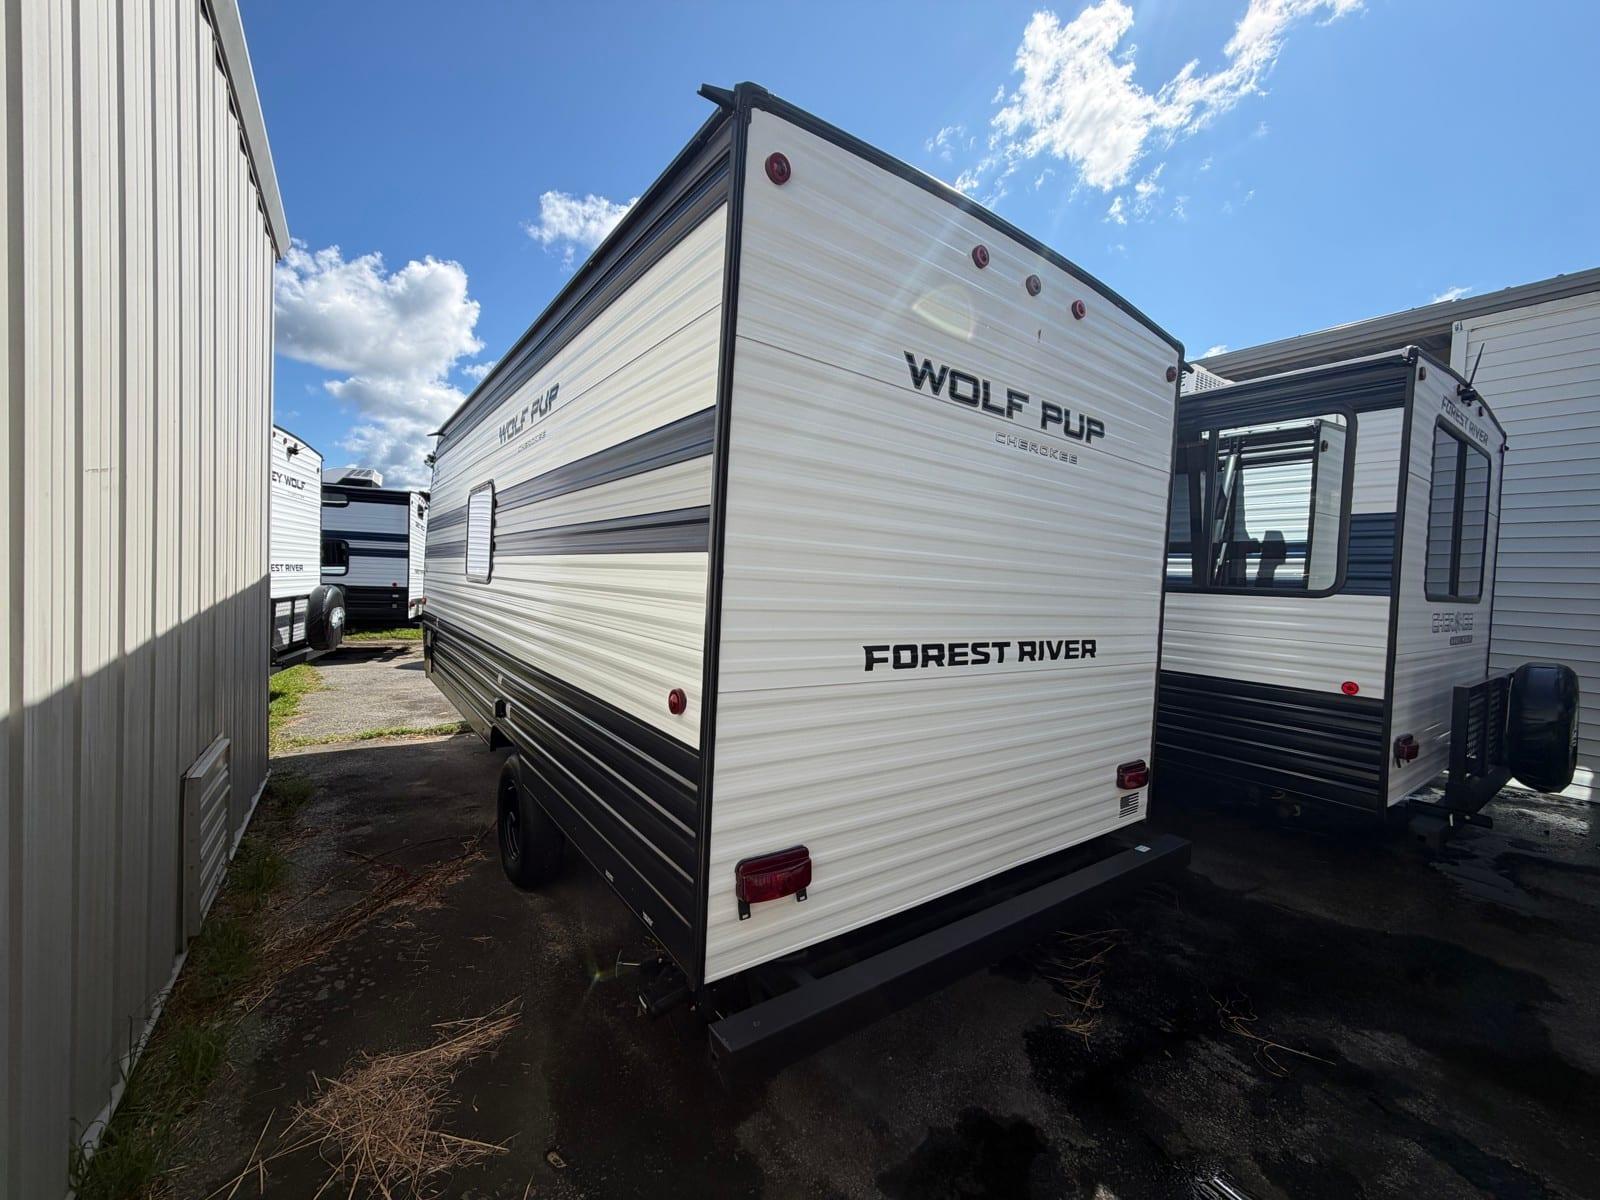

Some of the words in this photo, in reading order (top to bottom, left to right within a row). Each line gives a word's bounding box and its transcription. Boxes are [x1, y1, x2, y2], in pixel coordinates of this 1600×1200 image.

[498, 406, 530, 445] WOLF
[530, 382, 560, 424] PUP
[903, 350, 1030, 420] WOLF
[1040, 399, 1106, 444] PUP
[1440, 394, 1469, 430] FOREST
[1468, 420, 1489, 446] RIVER
[994, 431, 1079, 465] CHEROKEE
[283, 474, 306, 491] WOLF
[285, 563, 304, 572] RIVER
[862, 641, 1011, 672] FOREST
[1017, 639, 1097, 663] RIVER
